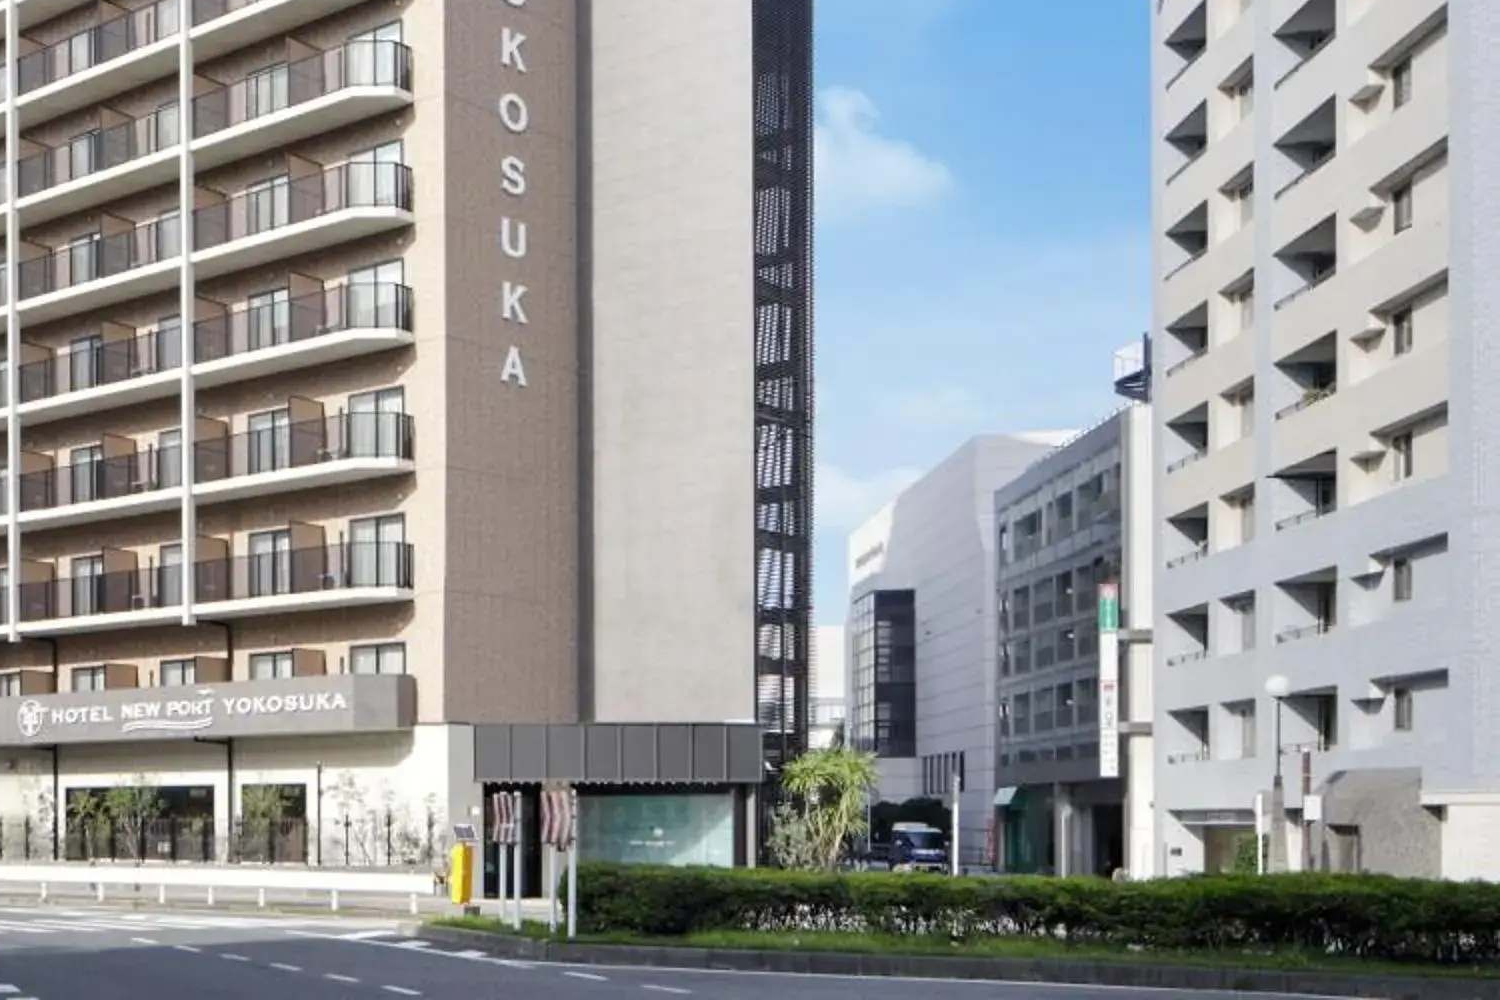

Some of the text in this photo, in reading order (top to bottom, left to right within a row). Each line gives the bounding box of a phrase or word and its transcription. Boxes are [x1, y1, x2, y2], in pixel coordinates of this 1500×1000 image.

[51, 692, 348, 725] HOTEL NEW PORT YOKOSUKA
